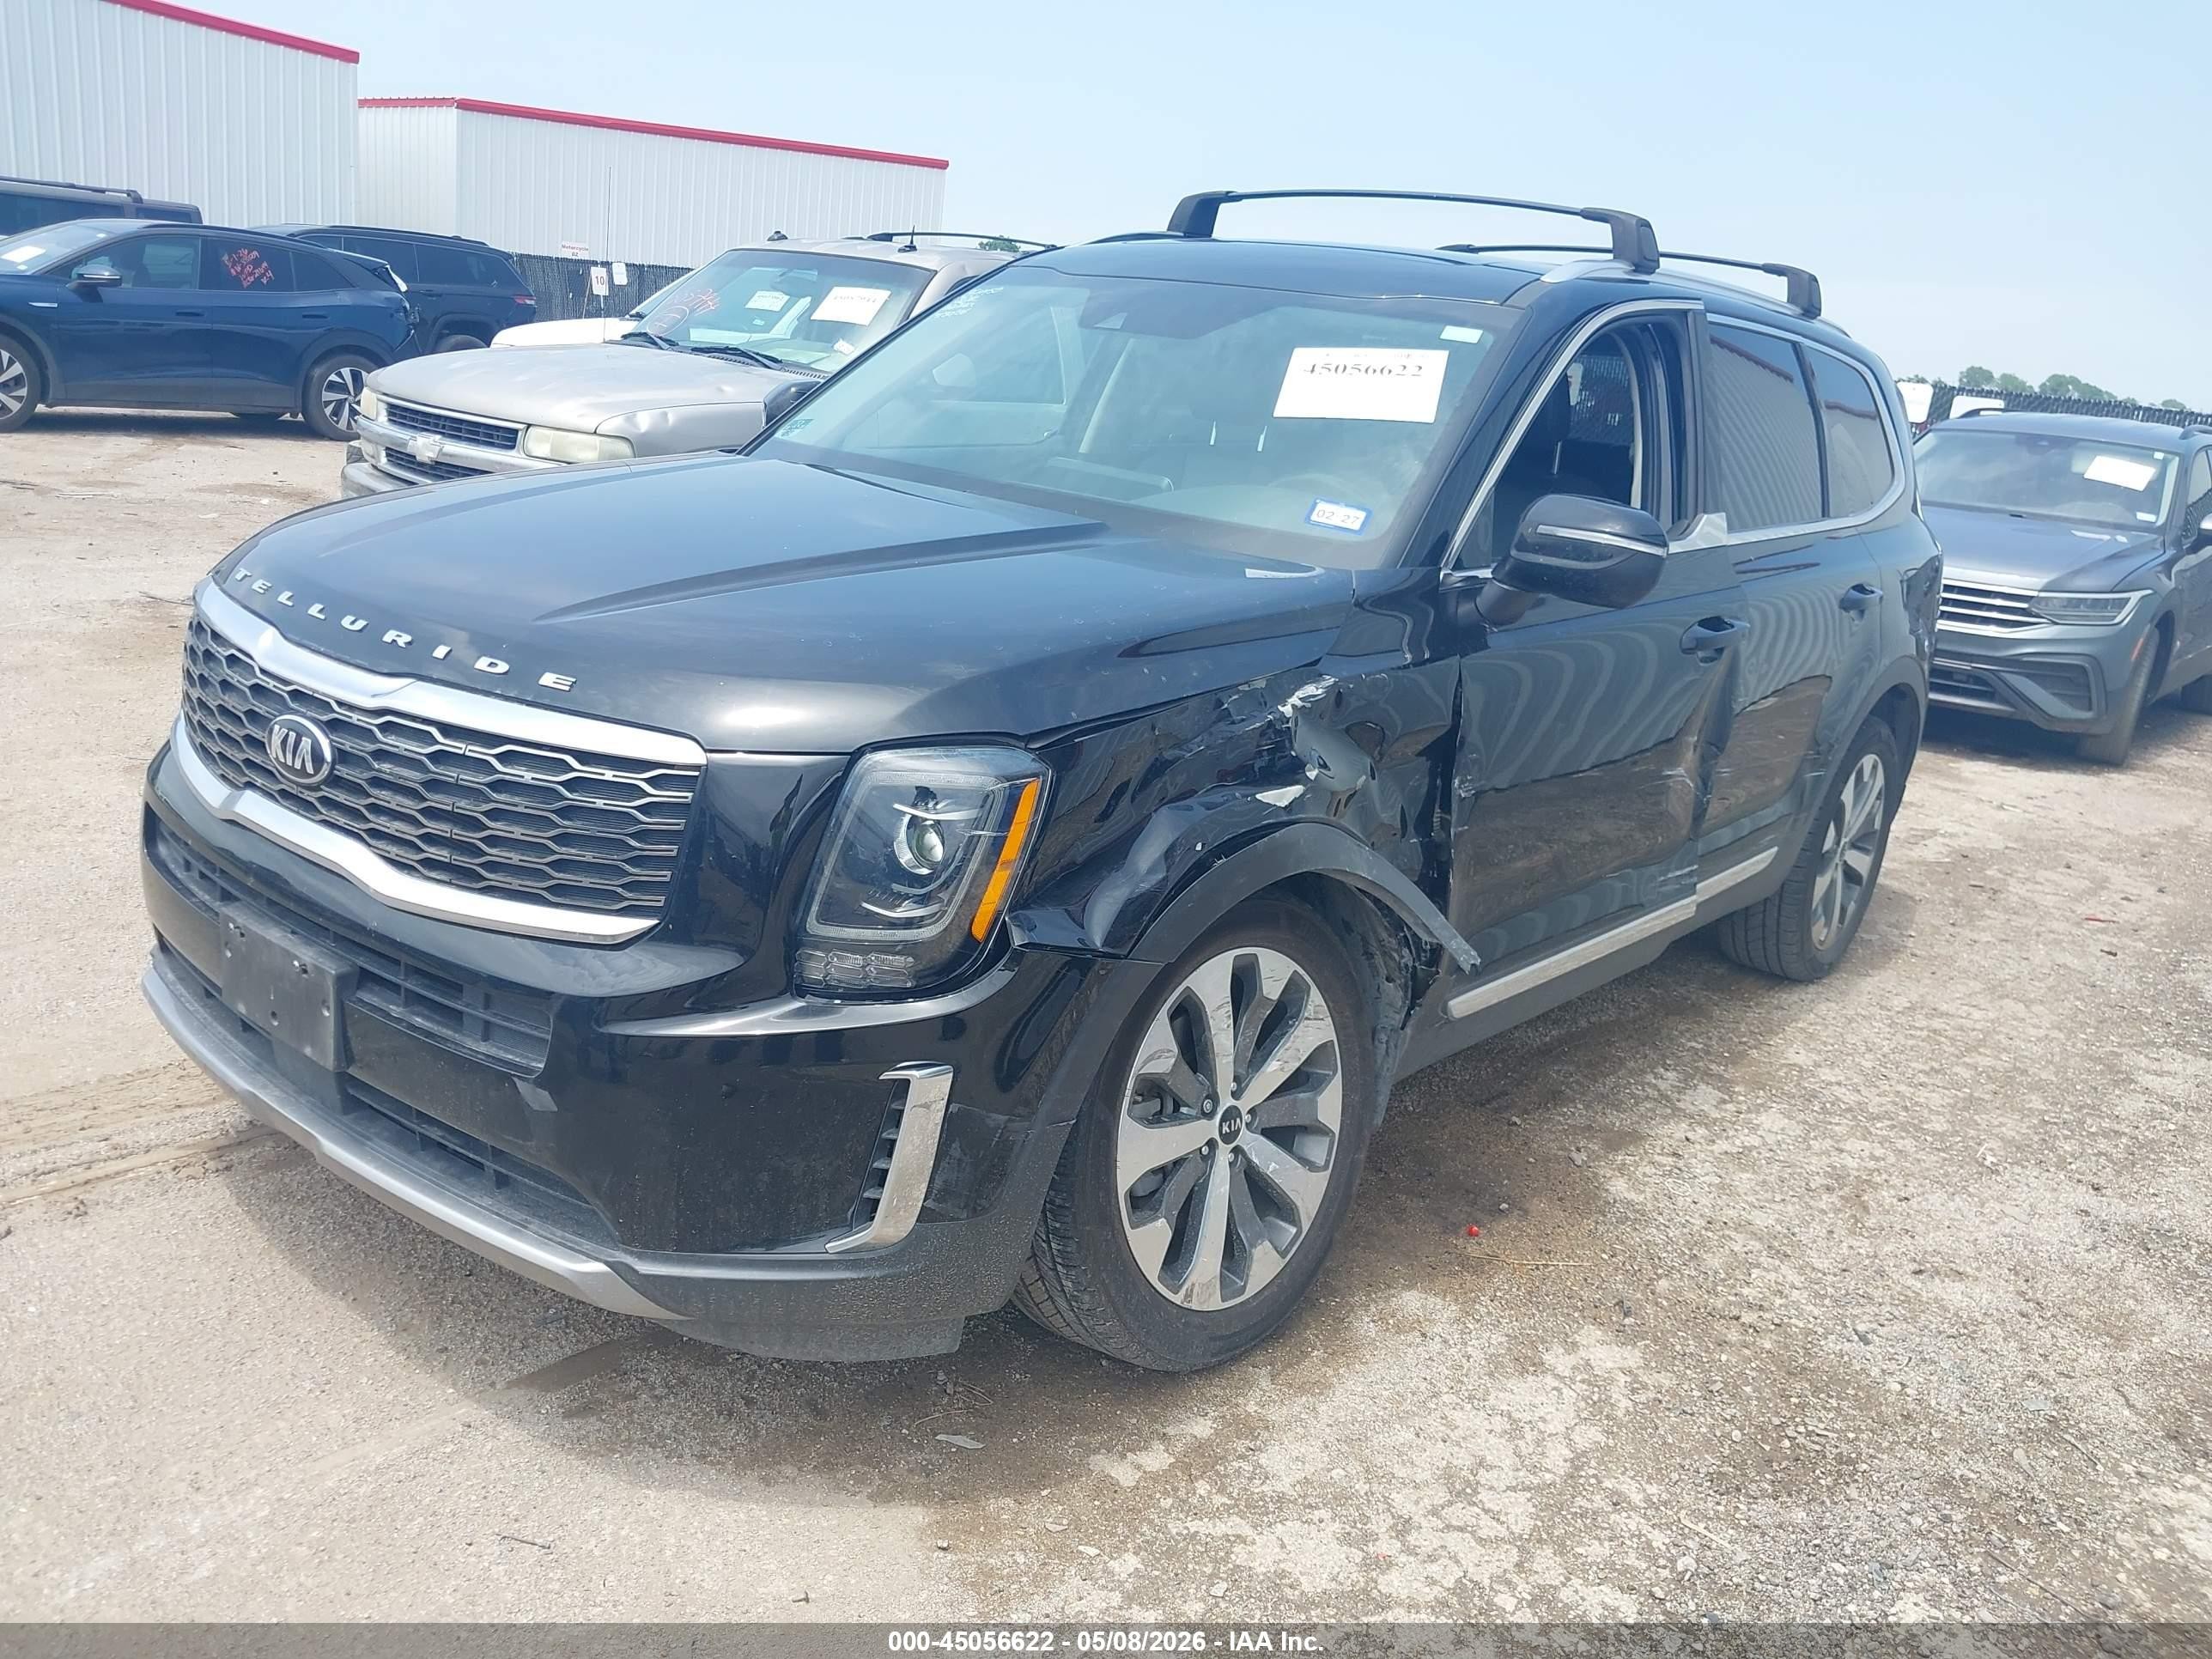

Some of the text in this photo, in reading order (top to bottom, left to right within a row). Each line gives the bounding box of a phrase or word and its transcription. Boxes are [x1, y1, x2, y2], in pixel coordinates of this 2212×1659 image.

[595, 276, 605, 286] 10
[1304, 363, 1423, 377] 45056622
[234, 567, 577, 691] TELLURIDE
[271, 724, 314, 775] KIA
[1222, 1117, 1243, 1134] KIA
